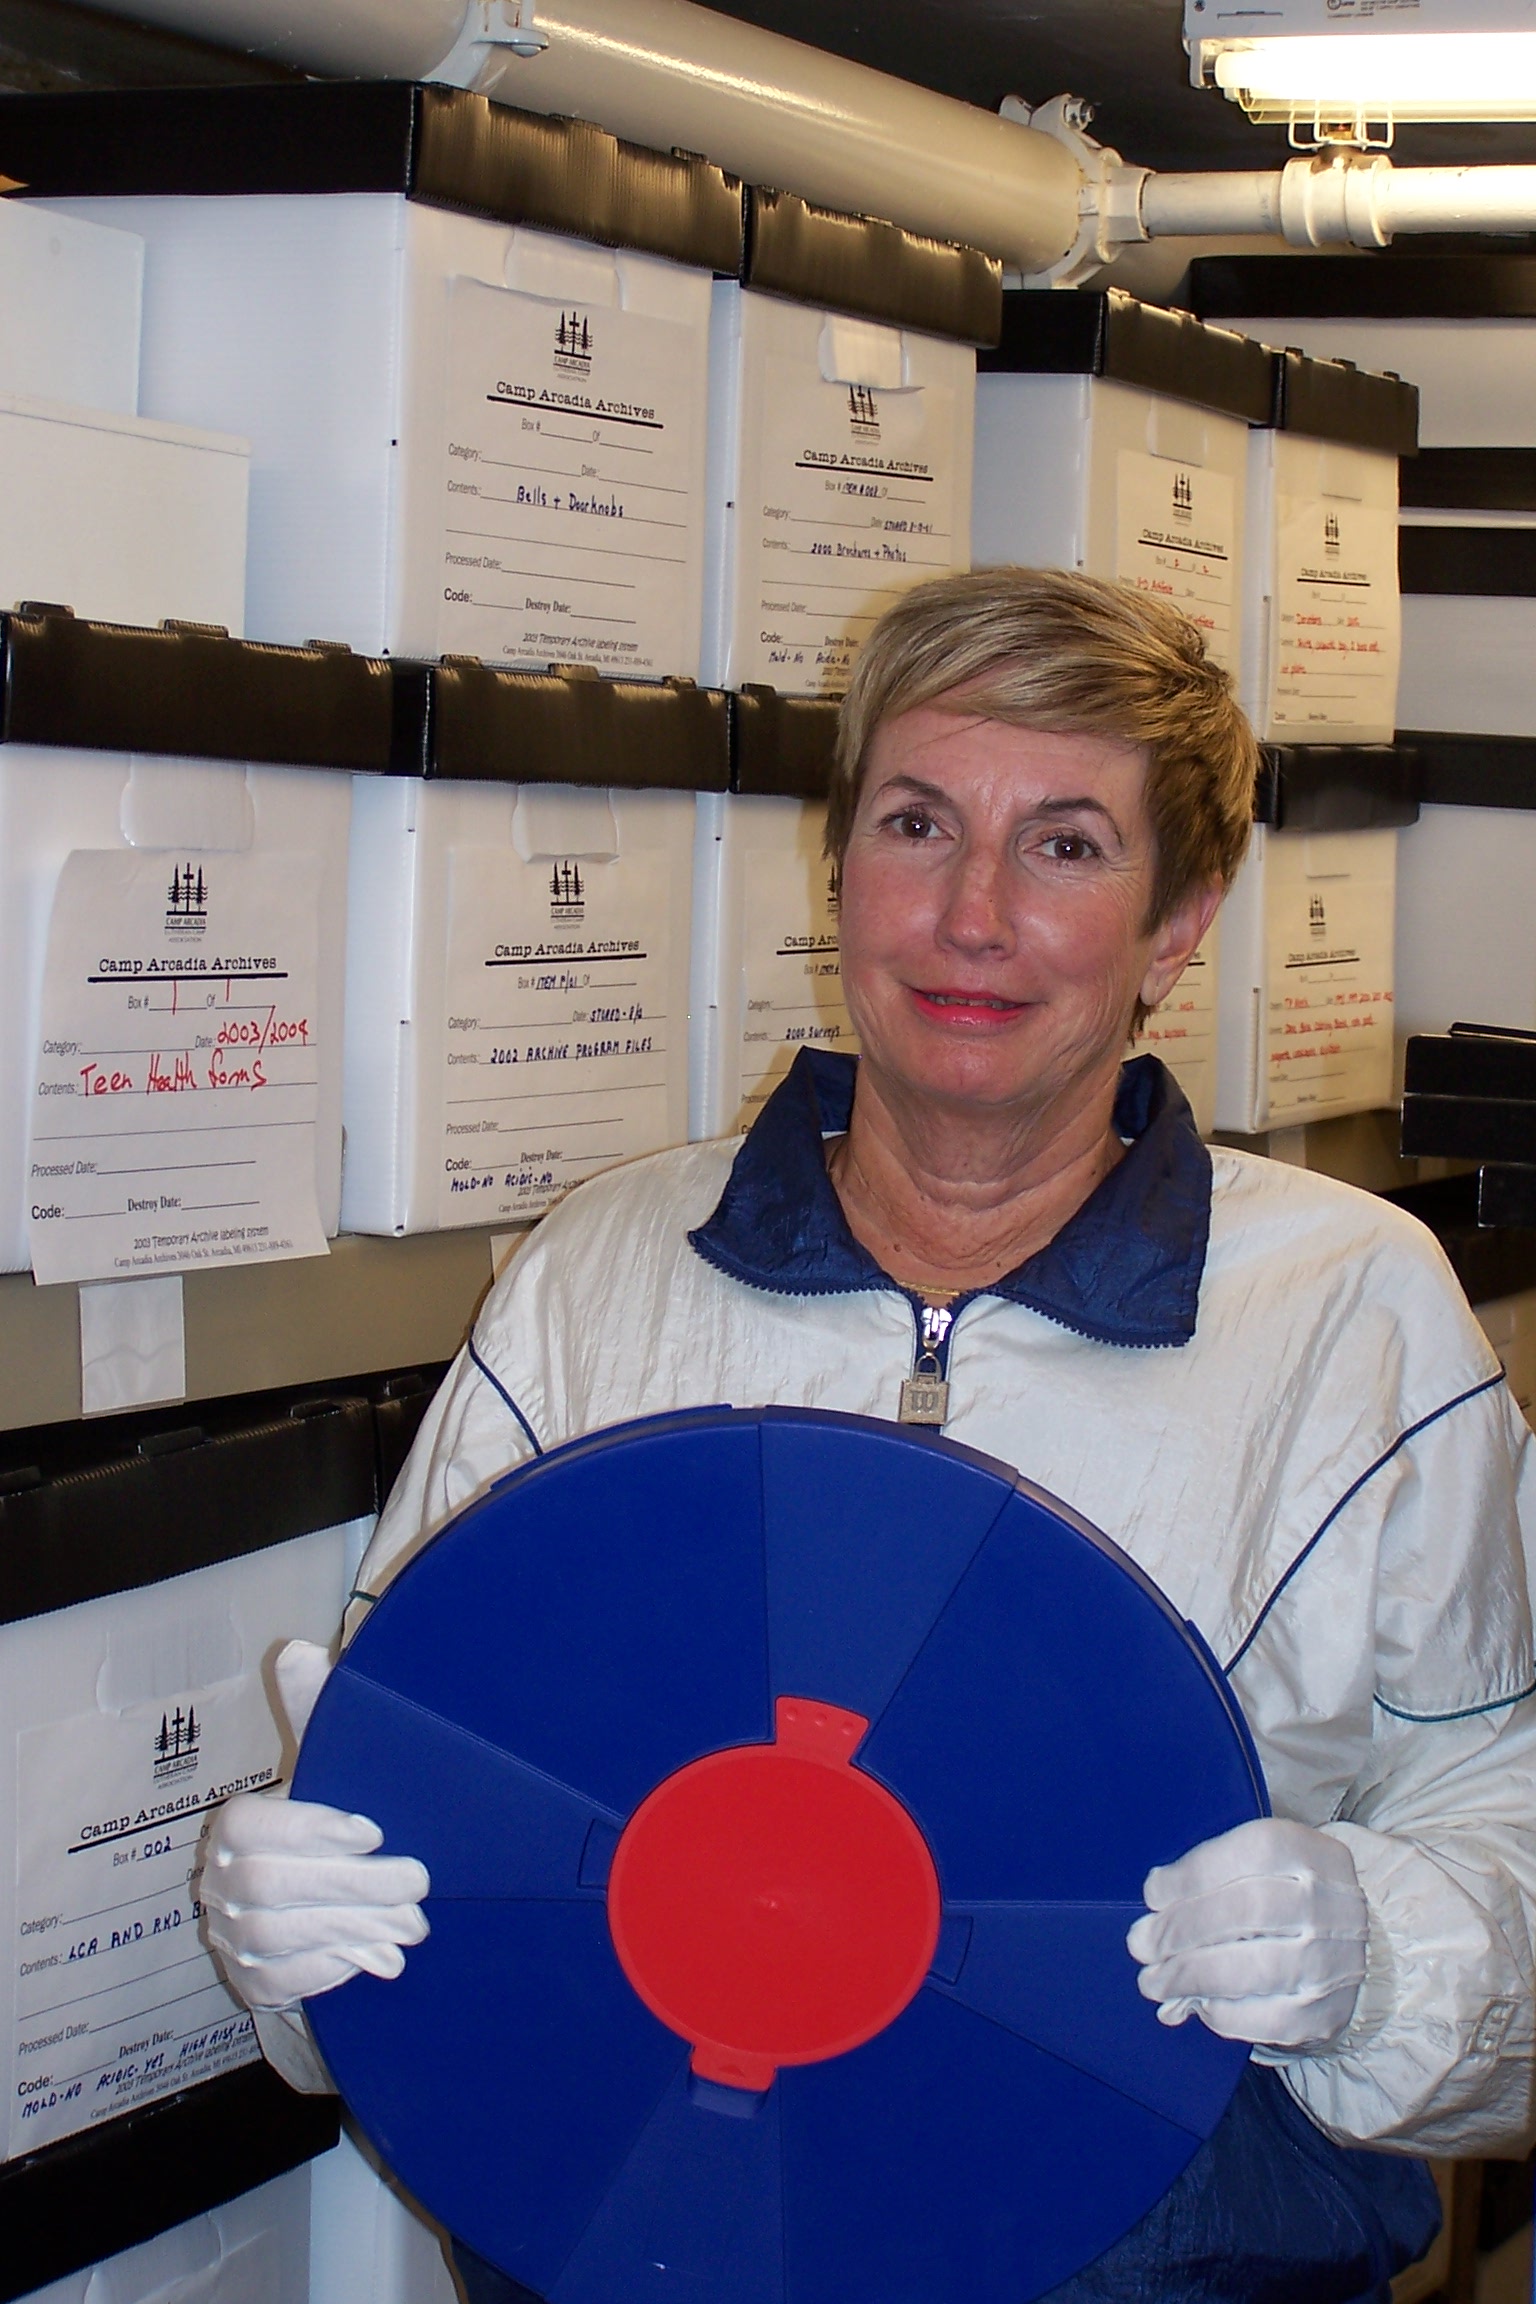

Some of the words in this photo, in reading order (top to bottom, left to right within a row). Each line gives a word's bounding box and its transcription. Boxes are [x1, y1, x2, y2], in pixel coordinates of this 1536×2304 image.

[496, 381, 536, 401] Camp
[539, 388, 592, 409] Arcadia
[596, 398, 655, 419] Archives
[521, 418, 534, 431] Box
[448, 443, 483, 463] Category:
[581, 464, 600, 478] Date:
[803, 449, 838, 465] Camp
[840, 453, 884, 468] Arcadia
[886, 459, 929, 474] Archives
[447, 481, 482, 497] Contents:
[516, 485, 547, 506] Bells
[568, 493, 624, 519] Doorknobs
[445, 552, 481, 568] Processed
[483, 556, 502, 571] Date:
[444, 588, 473, 603] Code:
[525, 597, 551, 614] Destroy
[552, 600, 571, 614] Date:
[760, 631, 784, 644] Code:
[495, 944, 532, 959] Camp
[535, 942, 584, 956] Arcadia
[586, 939, 640, 954] Archives
[784, 935, 816, 948] Camp
[99, 957, 143, 974] Camp
[146, 957, 207, 972] Arcadia
[210, 955, 277, 970] Archives
[128, 996, 142, 1010] Box
[142, 995, 149, 1007] #
[206, 994, 216, 1008] Of
[448, 1016, 481, 1032] Category:
[42, 1041, 81, 1059] Category:
[195, 1036, 216, 1049] Date:
[490, 1048, 519, 1065] 2002
[526, 1044, 569, 1062] ARCHIVE
[576, 1040, 619, 1059] PROGRAM
[625, 1037, 653, 1052] FILES
[447, 1054, 480, 1066] Contents:
[80, 1063, 133, 1097] Teen
[147, 1051, 197, 1095] Health
[38, 1082, 79, 1097] Contents:
[446, 1123, 480, 1136] Processed
[480, 1120, 499, 1133] Date:
[31, 1163, 75, 1178] Processed
[75, 1160, 97, 1175] Date:
[445, 1158, 472, 1172] Code:
[520, 1152, 545, 1165] Destroy
[545, 1149, 563, 1161] Date:
[31, 1205, 65, 1221] Code:
[127, 1197, 158, 1213] Destroy
[160, 1196, 182, 1209] Date:
[151, 1233, 189, 1249] Temporary
[190, 1229, 219, 1244] Archive
[219, 1227, 246, 1243] labeling
[114, 1256, 130, 1269] Camp
[154, 1762, 172, 1774] CAMP
[172, 1754, 197, 1768] ARCADIA
[80, 1815, 130, 1840] Camp
[134, 1793, 201, 1824] Arcadia
[203, 1767, 273, 1802] Archives
[113, 1852, 127, 1867] Box
[130, 1849, 137, 1860] #
[143, 1836, 172, 1858] 002
[20, 1913, 64, 1936] Category:
[68, 1937, 98, 1961] LCA
[111, 1922, 143, 1949] AND
[153, 1908, 181, 1935] RKD
[19, 1952, 63, 1977] Contents:
[18, 2034, 64, 2056] Processed
[65, 2022, 89, 2040] Date:
[179, 2038, 207, 2058] HIGH
[209, 2022, 237, 2044] RISK
[17, 2074, 54, 2097] Code:
[118, 2040, 149, 2060] Destroy
[152, 2029, 175, 2048] Date:
[135, 2063, 176, 2088] Temporary
